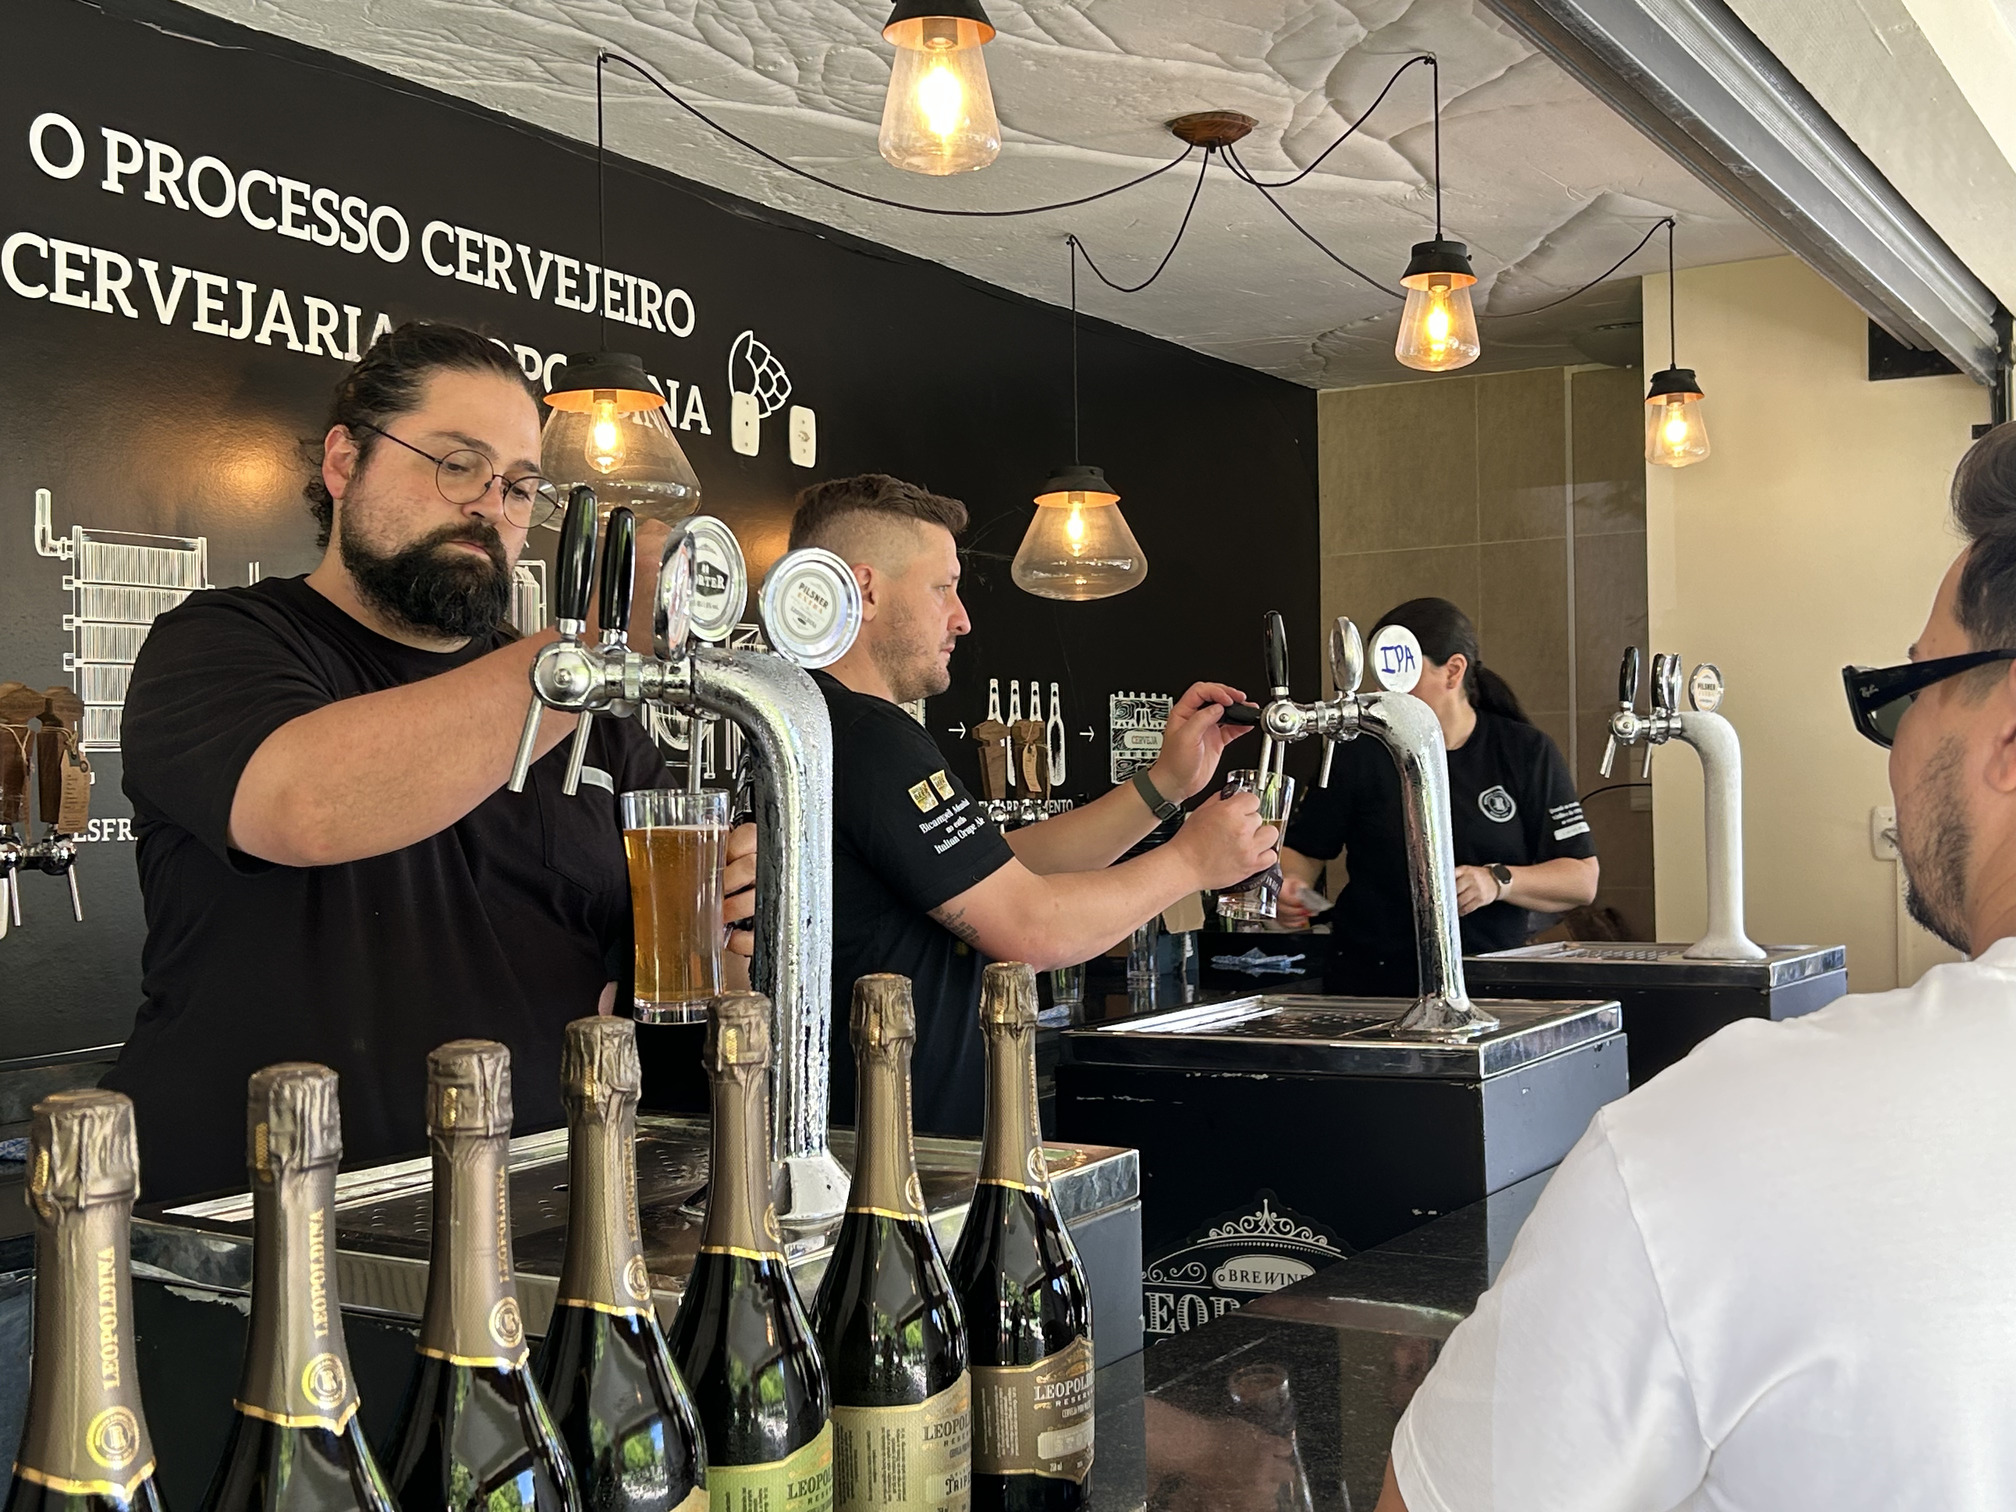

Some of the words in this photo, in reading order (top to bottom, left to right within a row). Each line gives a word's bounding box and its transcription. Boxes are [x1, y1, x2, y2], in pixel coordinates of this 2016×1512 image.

[29, 112, 85, 179] O
[101, 126, 409, 263] PROCESSO
[421, 220, 697, 338] CERVEJEIRO
[697, 574, 726, 590] RTER
[799, 582, 828, 609] PILSNER
[1381, 645, 1416, 674] IPA
[933, 835, 960, 854] Italian
[309, 1207, 329, 1339] LEOPOLDINA
[98, 1246, 121, 1391] LEOPOLDINA
